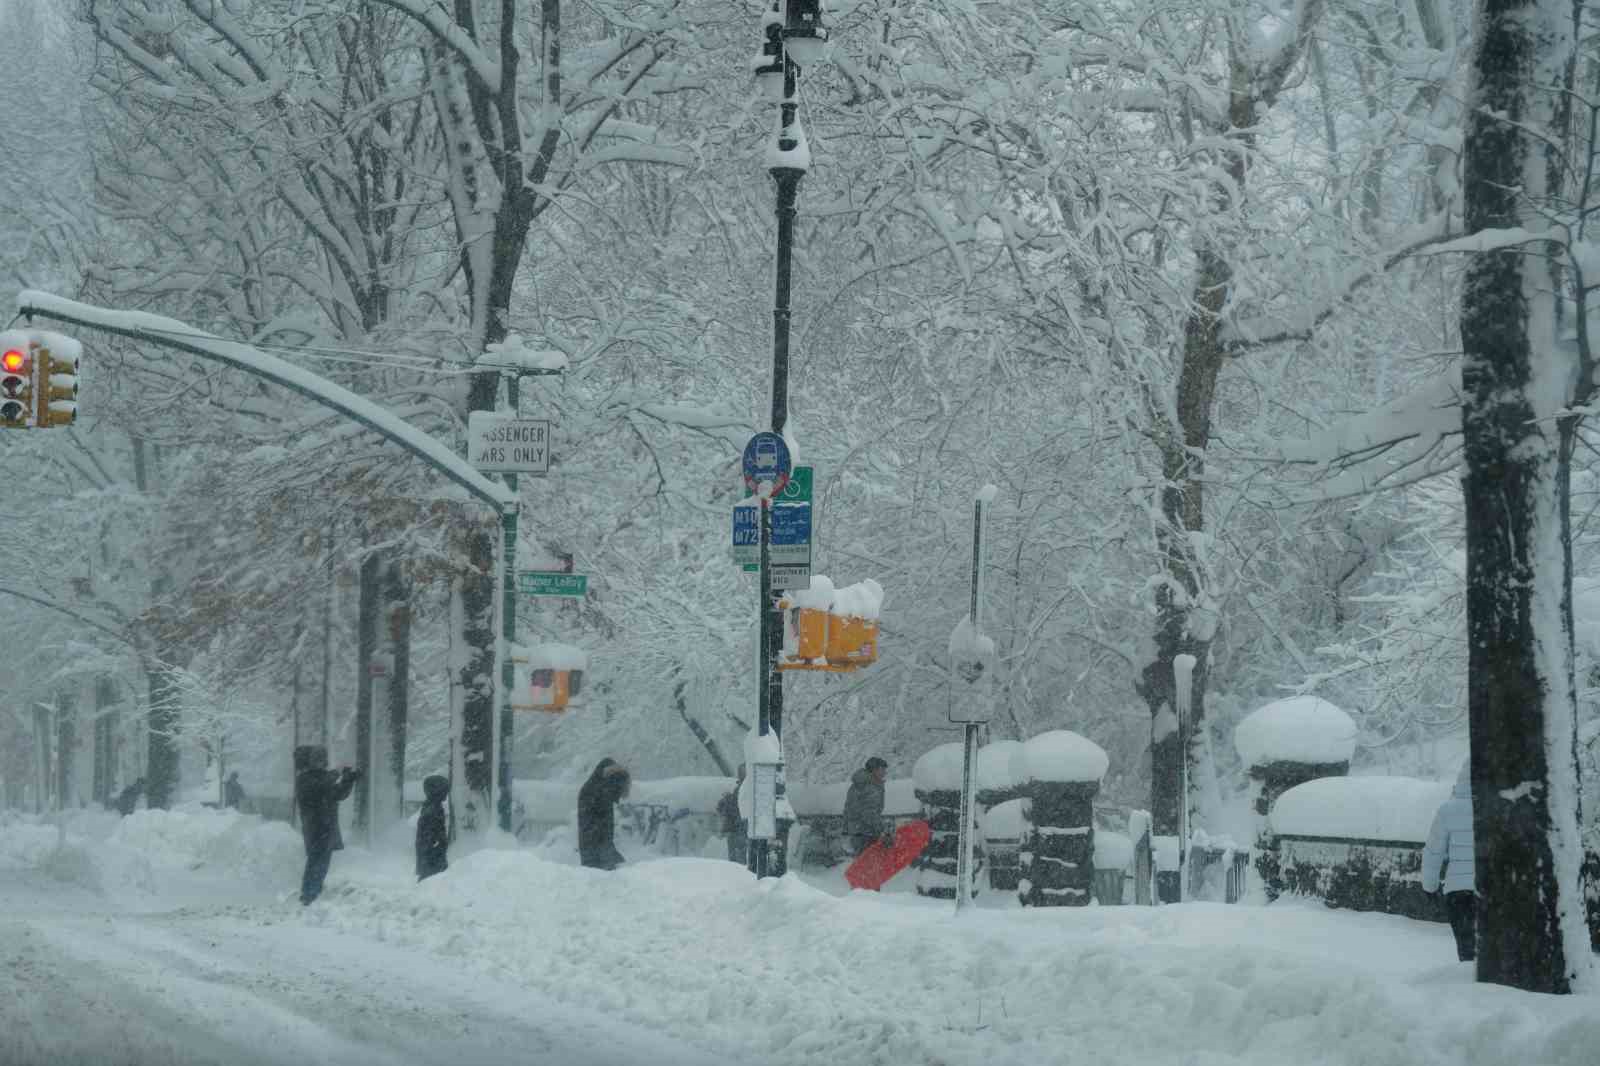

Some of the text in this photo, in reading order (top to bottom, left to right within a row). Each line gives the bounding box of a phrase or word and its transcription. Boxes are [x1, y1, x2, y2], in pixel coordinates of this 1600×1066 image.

[479, 427, 544, 442] ASSENGER
[479, 447, 544, 463] ARS ONLY
[735, 528, 757, 543] M72
